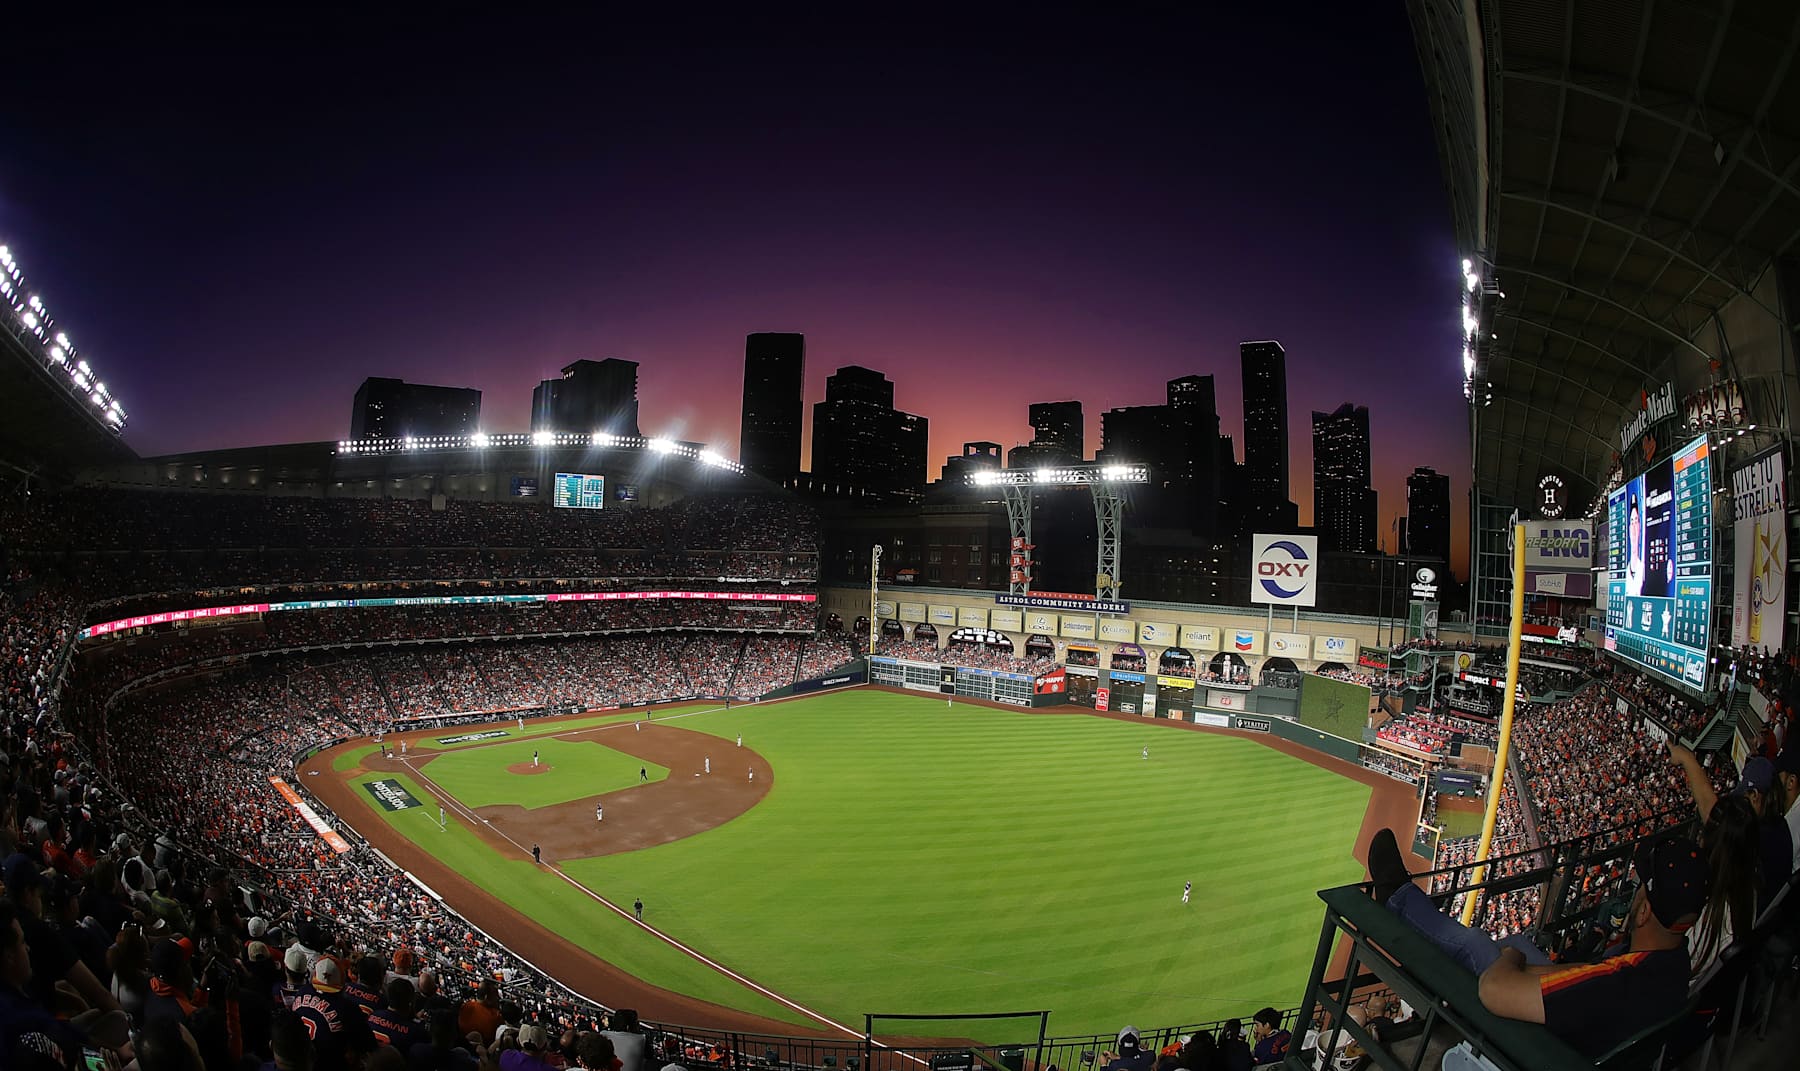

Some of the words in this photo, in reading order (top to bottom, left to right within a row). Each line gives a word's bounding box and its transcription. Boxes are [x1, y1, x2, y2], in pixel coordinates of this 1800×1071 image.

[1620, 409, 1648, 456] Minute
[1646, 381, 1675, 425] Maid
[1539, 475, 1563, 489] HOUSTON
[1733, 464, 1757, 495] VIVE
[1758, 456, 1773, 487] TU
[1544, 488, 1556, 504] H
[1734, 483, 1782, 521] ESTRELLA
[1540, 504, 1562, 517] ASTROS
[1524, 536, 1578, 549] REEPORT
[1540, 528, 1590, 558] LNG
[1257, 561, 1310, 578] OXY
[999, 596, 1029, 604] ASTROS
[1031, 598, 1084, 609] COMMUNITY
[1086, 602, 1126, 612] LEADERS
[1185, 631, 1211, 641] reliant
[1464, 674, 1490, 686] impact
[1243, 720, 1269, 729] VERITEX
[345, 985, 380, 1003] TUCKER
